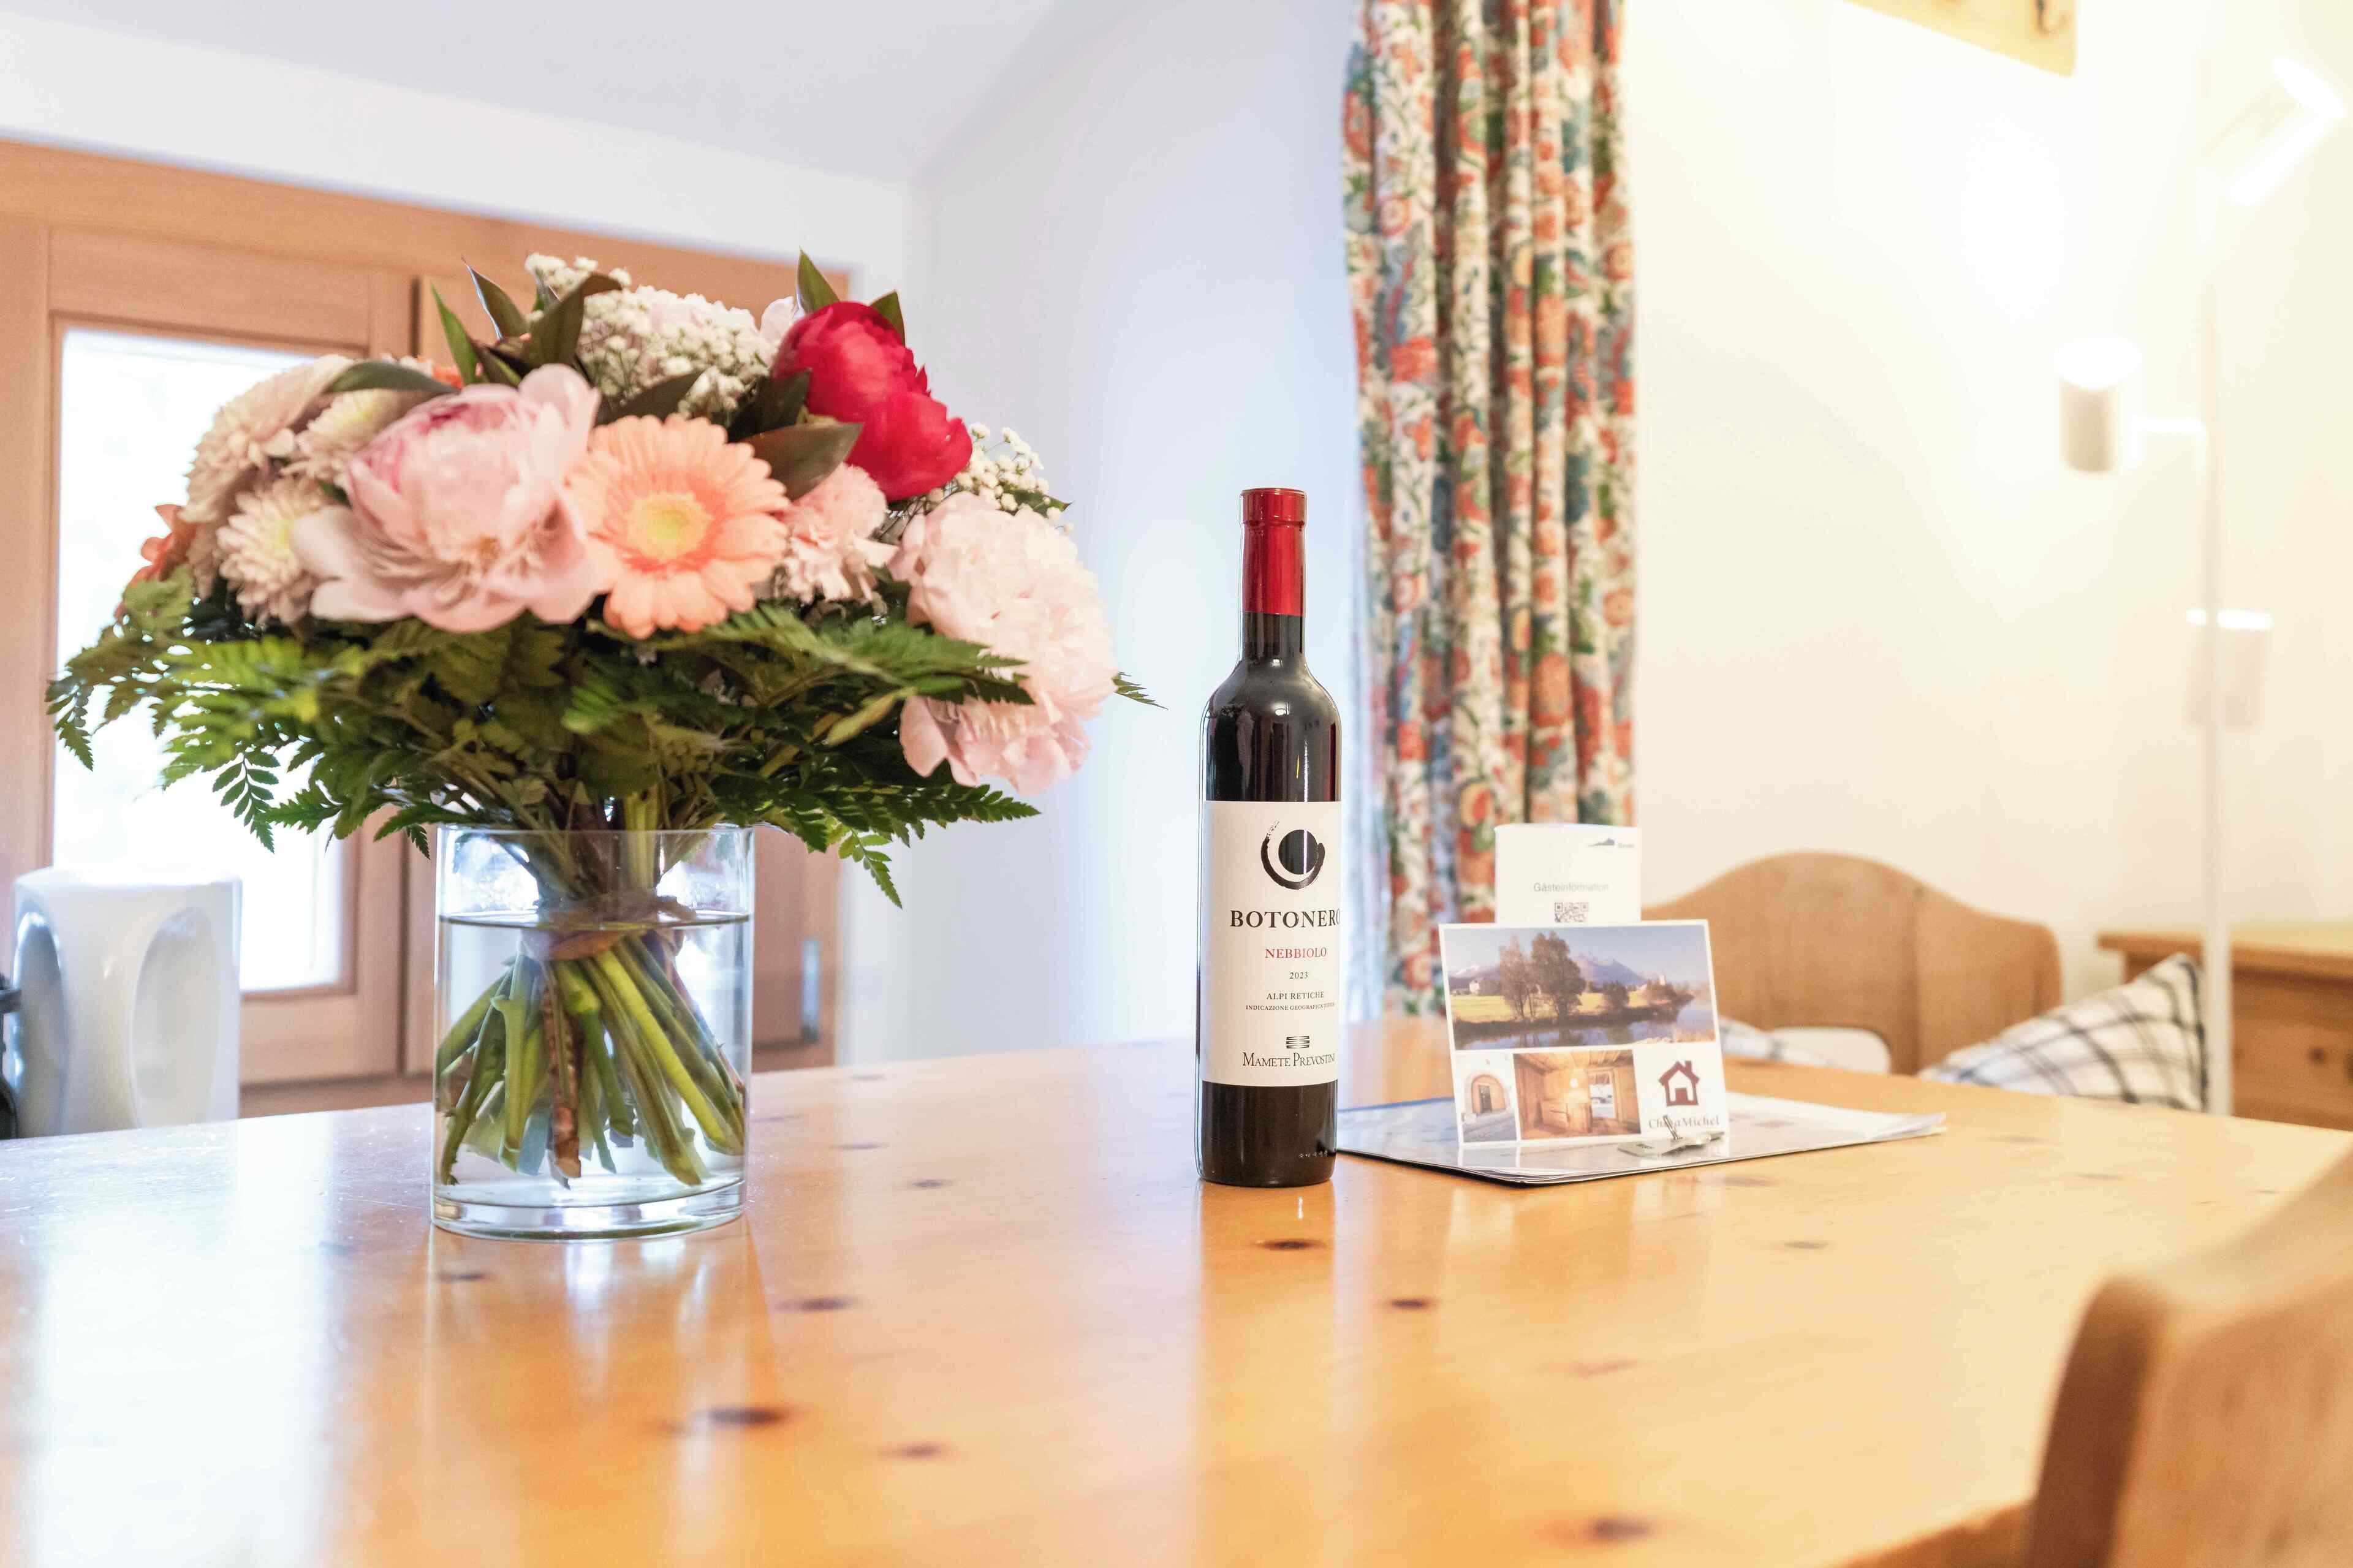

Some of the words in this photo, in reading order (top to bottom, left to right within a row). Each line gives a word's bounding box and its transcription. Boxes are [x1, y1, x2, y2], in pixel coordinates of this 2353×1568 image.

[1265, 947, 1327, 959] NEBBIOLO
[1290, 991, 1324, 999] RETICHE
[1243, 1052, 1290, 1067] MAMETE
